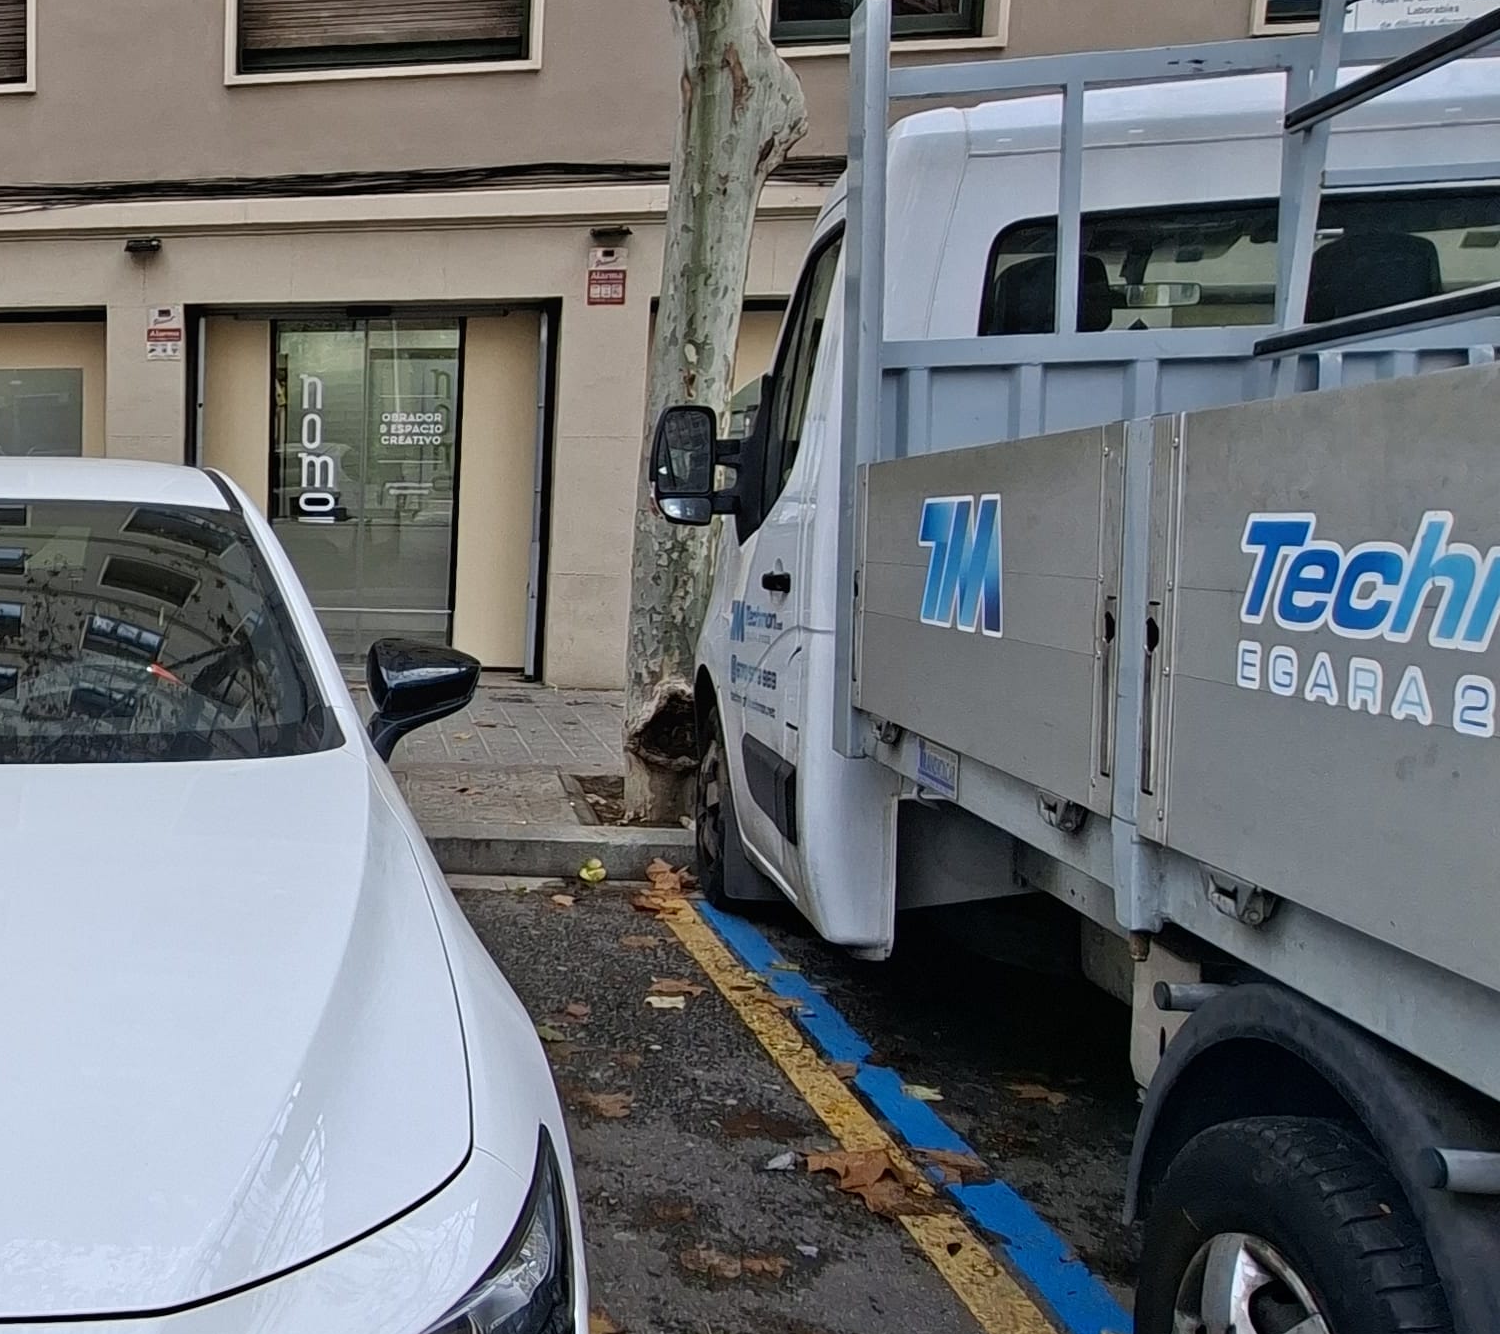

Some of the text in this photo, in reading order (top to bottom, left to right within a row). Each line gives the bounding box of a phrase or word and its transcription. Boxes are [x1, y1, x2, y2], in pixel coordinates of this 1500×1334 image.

[381, 412, 442, 422] OBRADOR
[390, 424, 443, 434] ESPACIO
[381, 435, 441, 445] CREATIVO
[1237, 640, 1496, 738] EGARA 2
